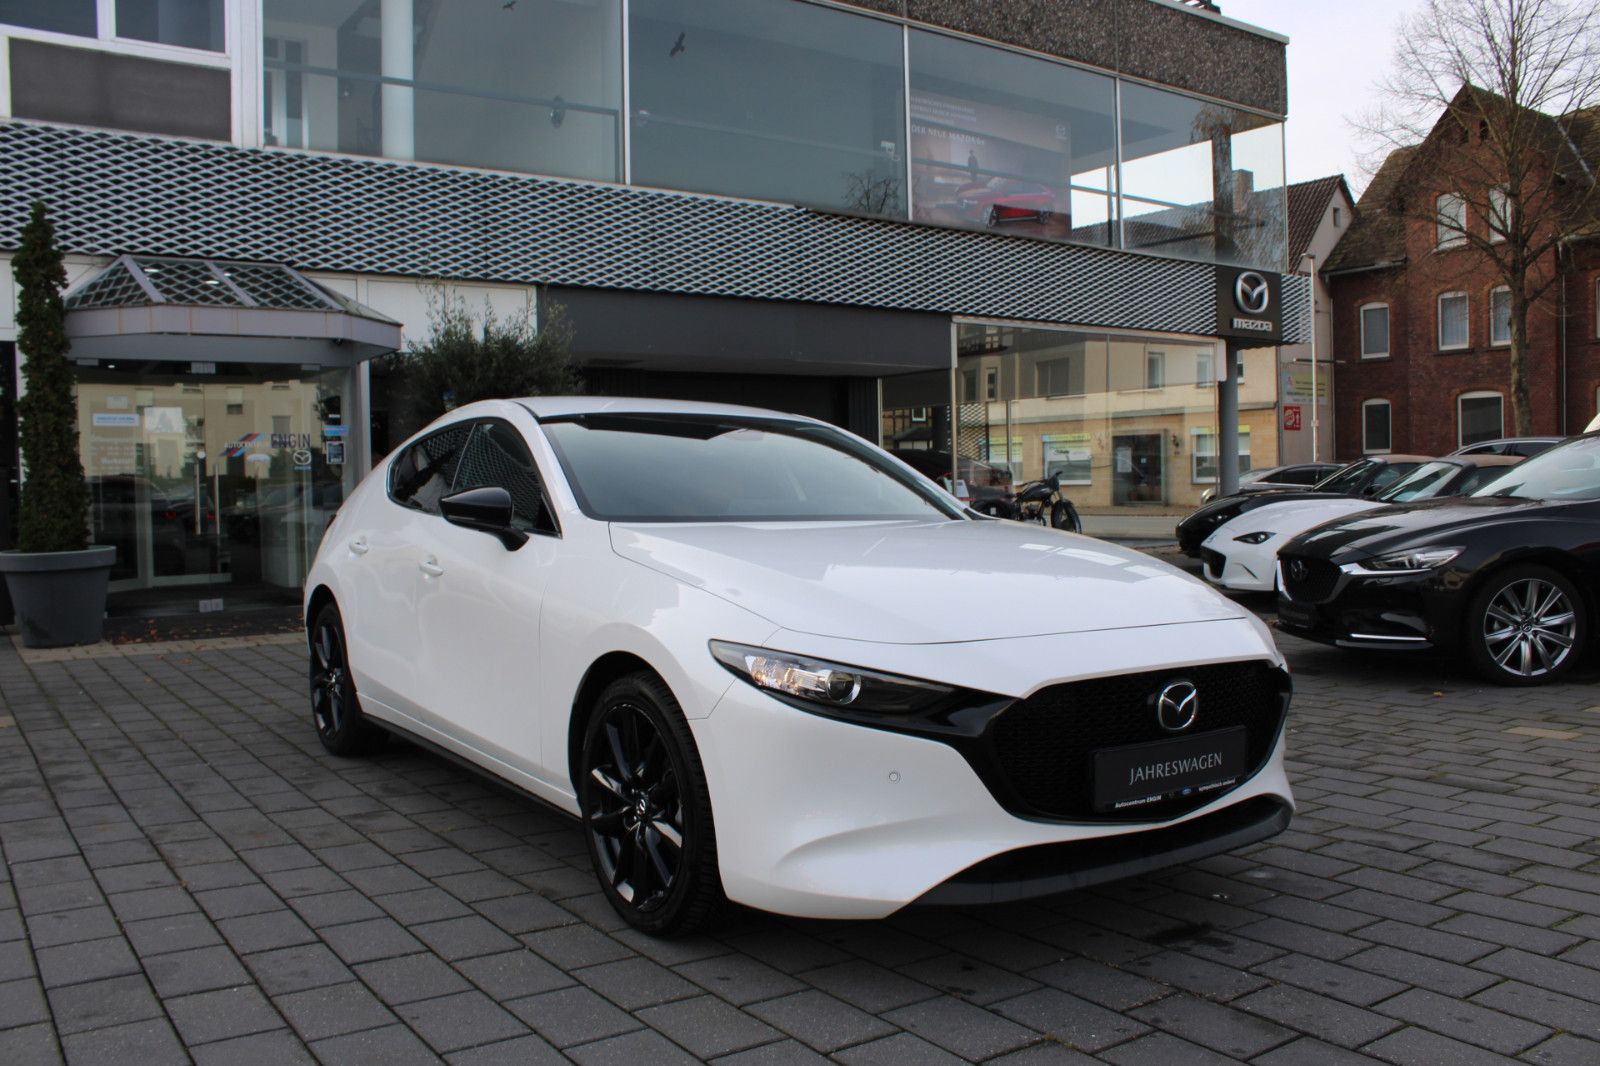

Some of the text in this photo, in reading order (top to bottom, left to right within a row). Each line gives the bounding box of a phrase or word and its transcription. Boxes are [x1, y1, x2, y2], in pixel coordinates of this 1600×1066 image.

[1232, 317, 1273, 332] mazda
[270, 433, 311, 449] ENGIN
[1129, 752, 1223, 786] JAHRESWAGEN
